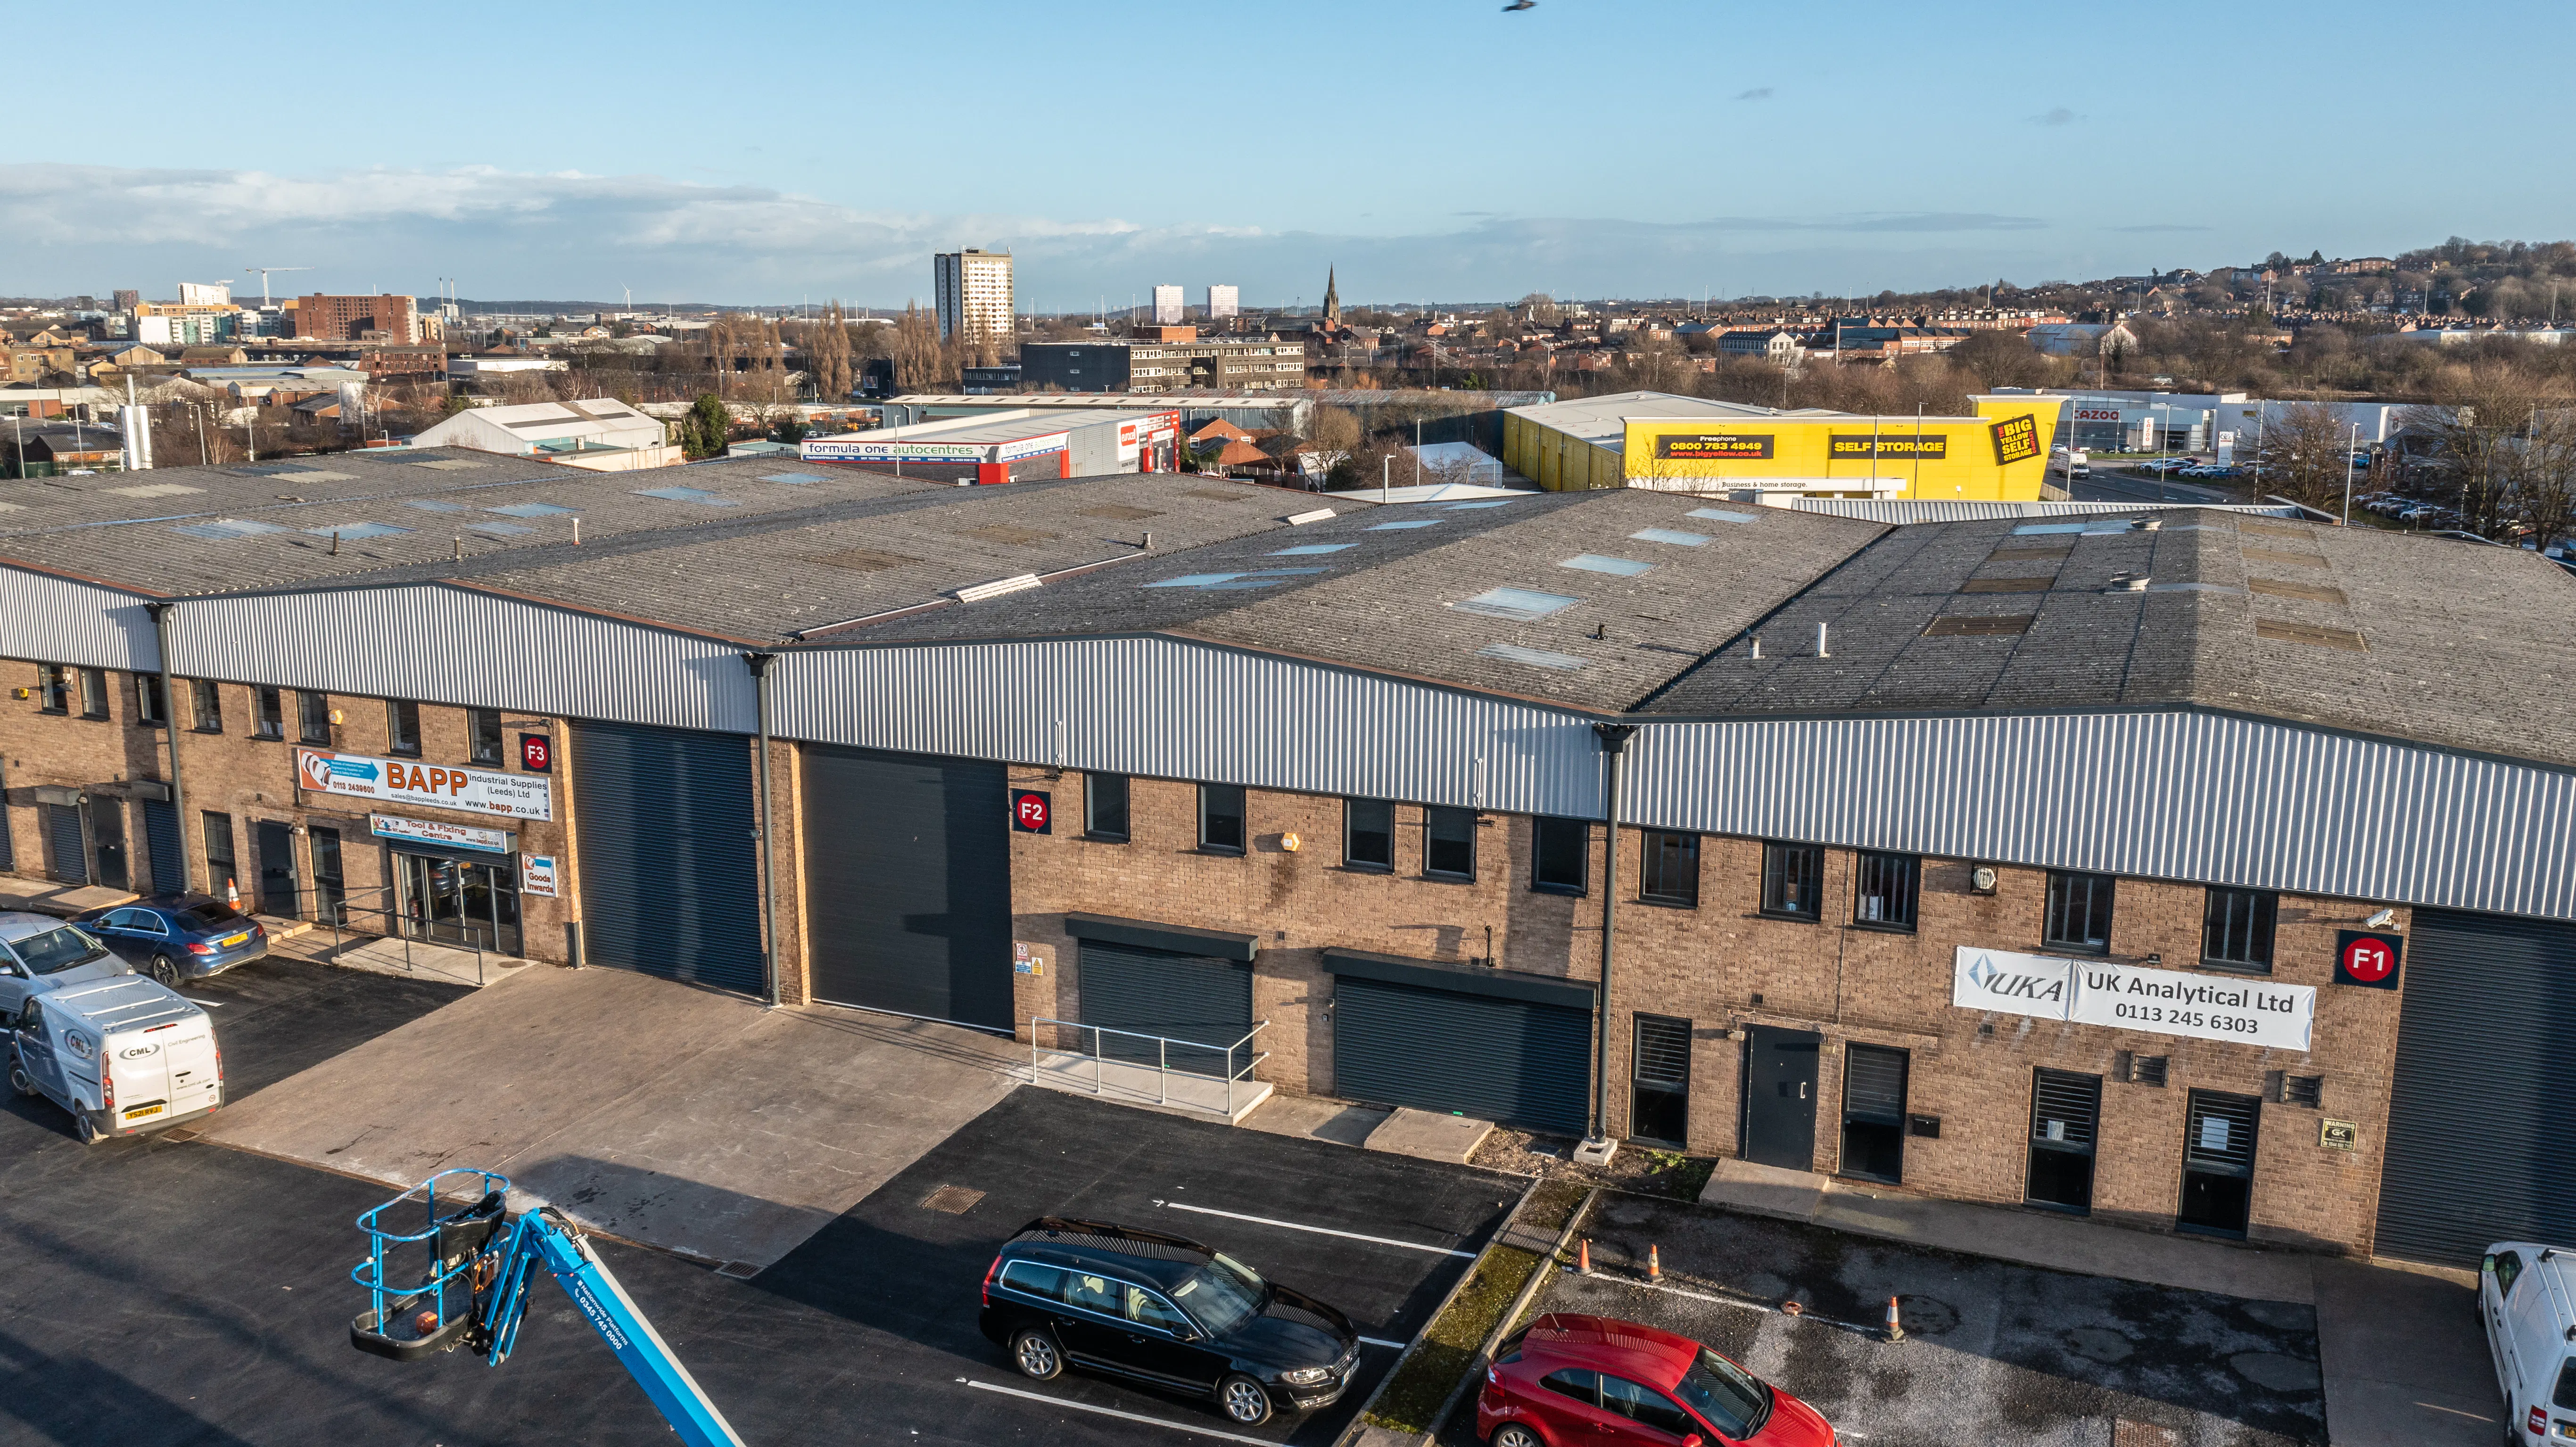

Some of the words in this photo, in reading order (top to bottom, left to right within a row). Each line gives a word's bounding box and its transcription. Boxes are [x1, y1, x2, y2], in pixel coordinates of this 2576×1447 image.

[2072, 410, 2119, 420] CAZOO
[2004, 419, 2032, 436] BIG
[2000, 432, 2028, 444] YELLOW
[2029, 431, 2037, 453] COMPANY
[809, 444, 860, 453] formula
[865, 445, 888, 453] one
[893, 445, 973, 454] autocentres
[1006, 443, 1024, 454] formula
[1834, 442, 1872, 452] SELF
[1876, 442, 1944, 452] STORAGE
[2002, 438, 2030, 454] SELF
[2004, 448, 2033, 461] STORAGE
[528, 745, 545, 761] F3
[333, 781, 346, 790] 0113
[387, 763, 468, 797] BAPP
[469, 774, 508, 786] Industrial
[511, 781, 547, 790] Supplies
[487, 786, 516, 798] (Leeds)
[518, 790, 530, 798] Ltd
[391, 793, 457, 806] sales@bappleeds.co.uk
[465, 800, 541, 816] www.bapp.co.uk
[1022, 803, 1043, 821] F2
[405, 820, 425, 830] Tool
[438, 825, 466, 836] Fixing
[422, 830, 452, 840] Centre
[528, 872, 551, 883] Goods
[528, 882, 553, 894] Inwards
[2353, 948, 2385, 971] F1
[1990, 973, 2064, 1002] UKA
[2088, 972, 2121, 992] UK
[2127, 977, 2248, 1008] Analytical
[2257, 992, 2294, 1013] Ltd
[2116, 1003, 2162, 1021] 0113
[2169, 1010, 2204, 1027] 245
[2211, 1015, 2258, 1034] 6303
[71, 1035, 85, 1053] CML
[179, 1034, 205, 1044] Engineering
[130, 1047, 151, 1056] CML
[2325, 1120, 2355, 1129] WARNING
[2331, 1129, 2345, 1137] GK
[581, 1285, 606, 1317] Nationwide
[606, 1317, 628, 1345] Platforms
[580, 1297, 596, 1316] 0345
[594, 1315, 607, 1331] 745
[606, 1330, 622, 1349] 0000
